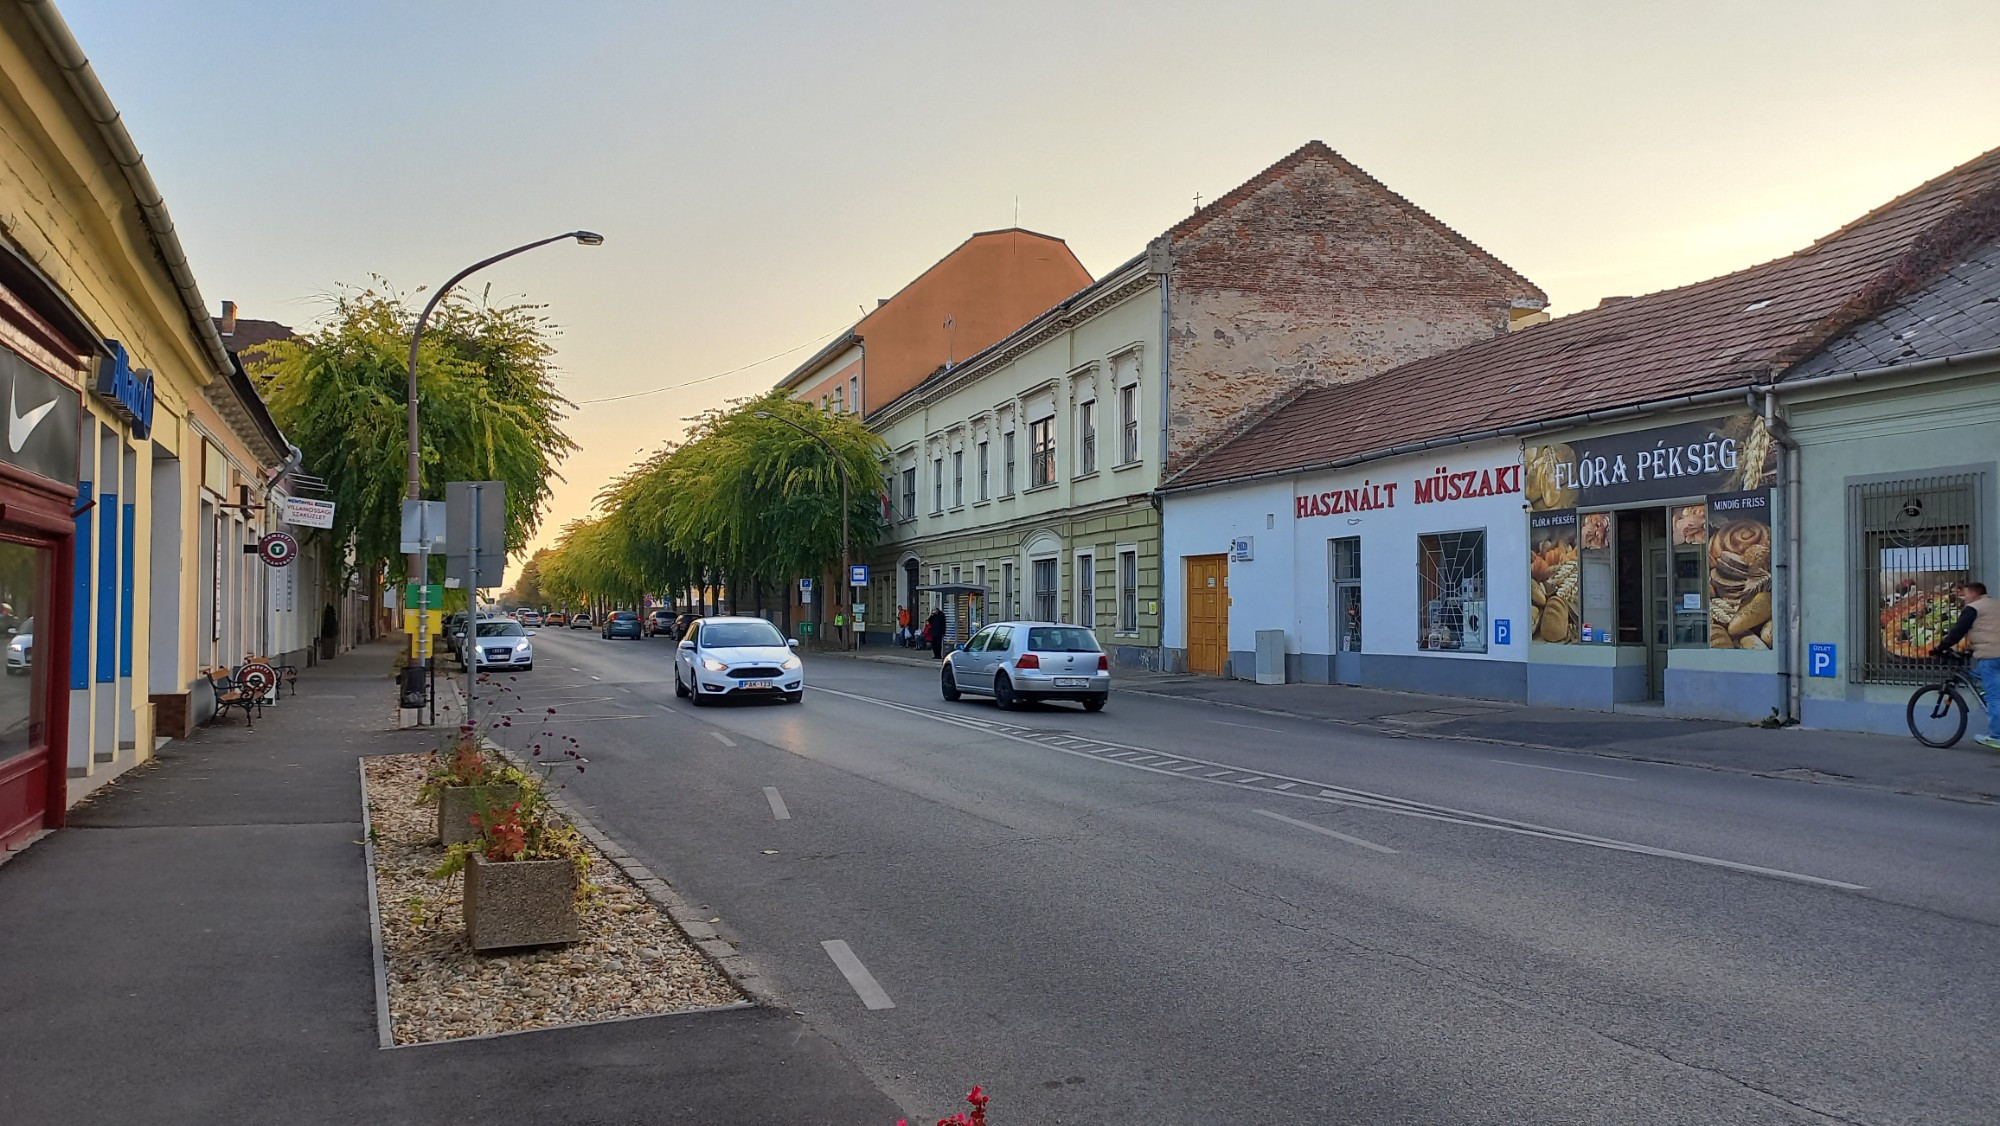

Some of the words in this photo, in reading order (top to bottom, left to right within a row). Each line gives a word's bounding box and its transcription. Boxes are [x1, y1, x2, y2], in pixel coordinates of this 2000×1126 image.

[1555, 451, 1629, 490] FLÓRA
[1637, 432, 1738, 481] PÉKSÉG
[1296, 480, 1397, 518] HASZNÁLT
[1713, 499, 1740, 510] MINDIG
[1741, 497, 1765, 508] FRISS
[1532, 517, 1550, 527] FLÓRA
[1551, 514, 1575, 525] PÉKSÉG
[1498, 625, 1507, 643] P
[1815, 653, 1830, 675] P
